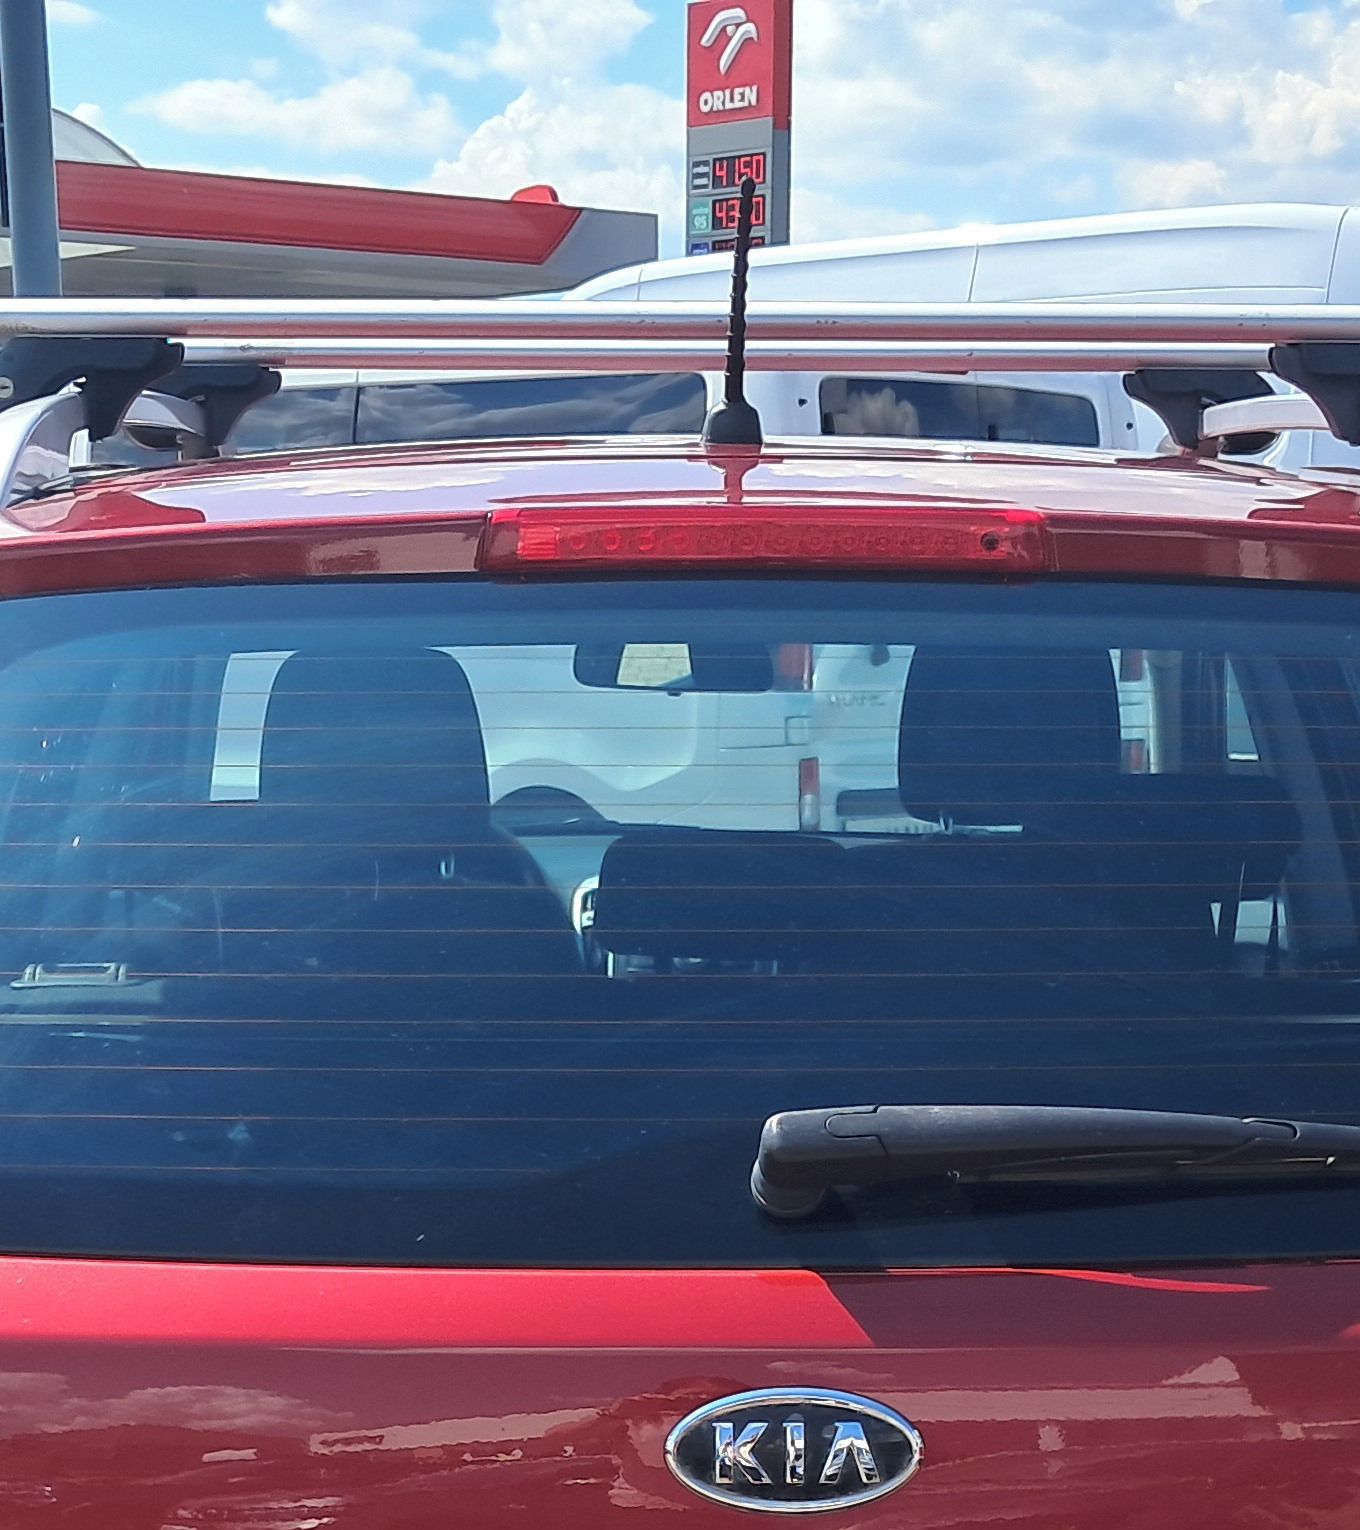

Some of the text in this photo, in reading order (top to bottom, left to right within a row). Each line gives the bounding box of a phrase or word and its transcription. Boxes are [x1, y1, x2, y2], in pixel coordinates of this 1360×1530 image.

[699, 84, 759, 113] ORLEN
[715, 196, 764, 230] 430
[711, 1421, 881, 1485] KIA
